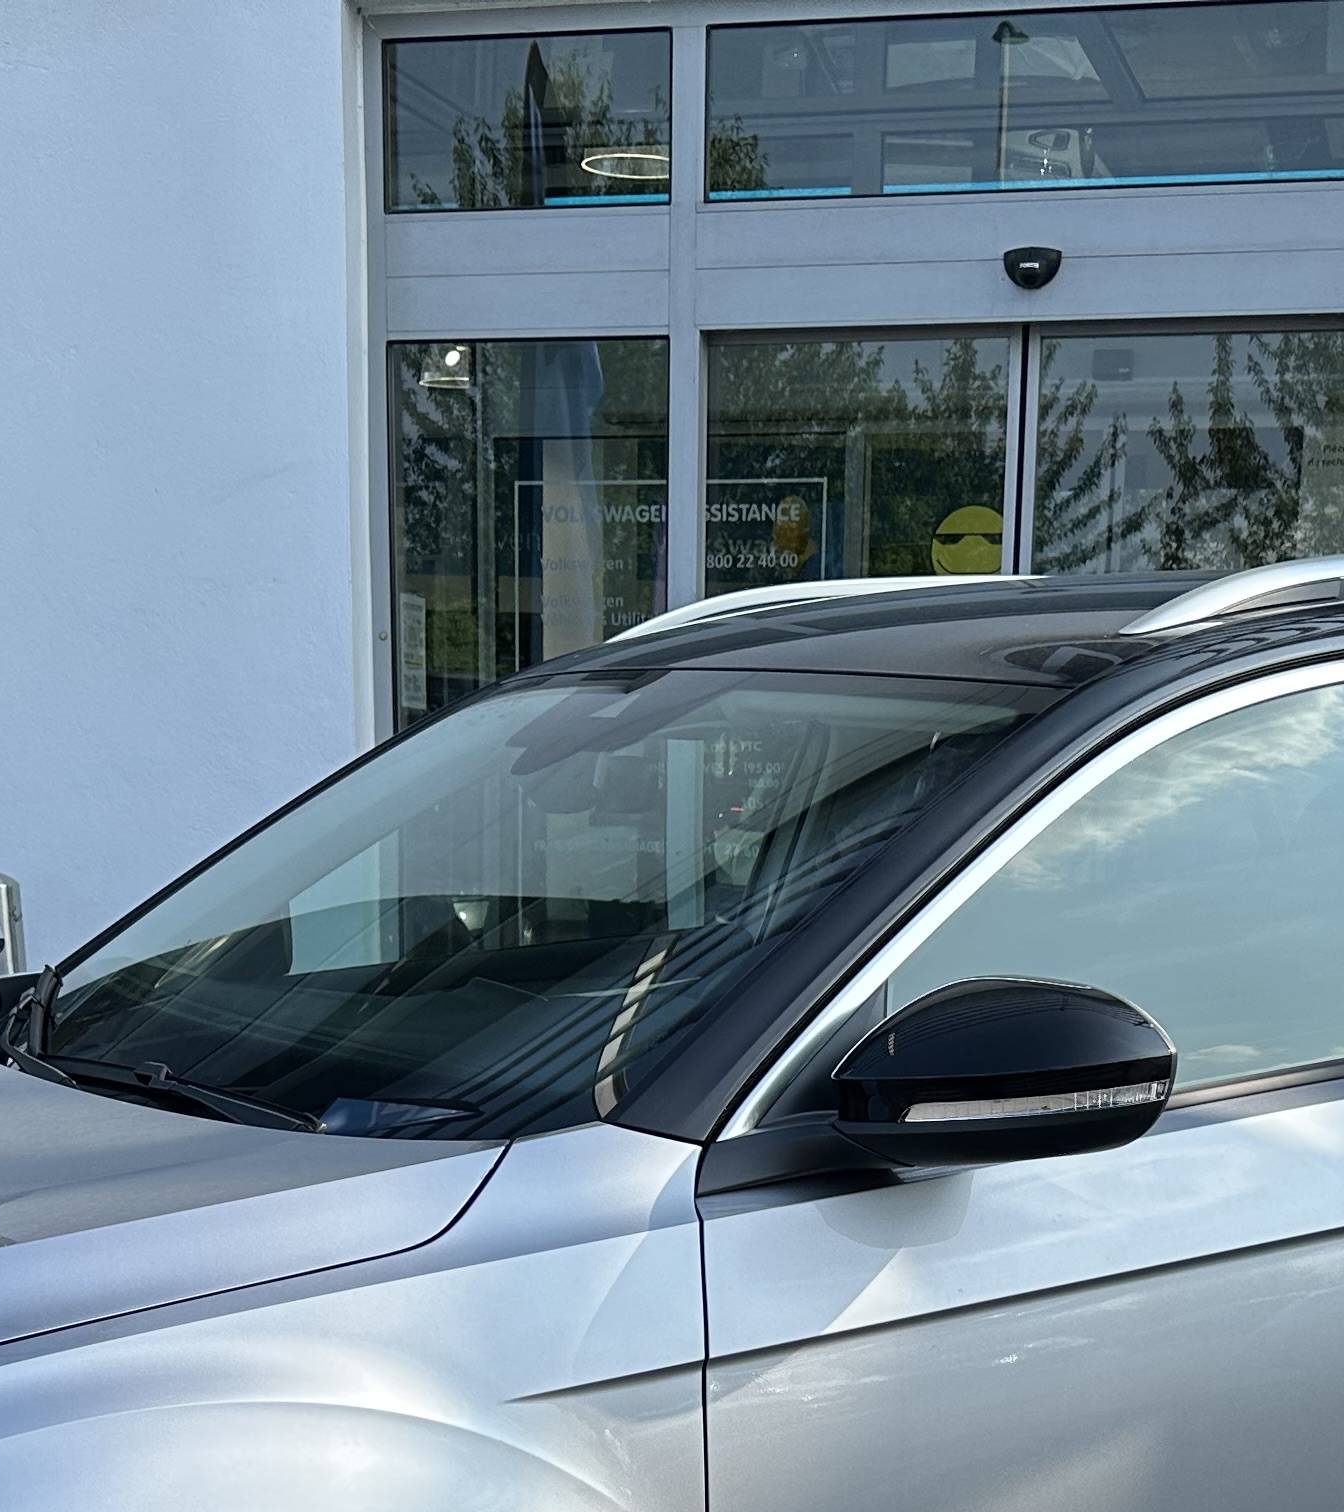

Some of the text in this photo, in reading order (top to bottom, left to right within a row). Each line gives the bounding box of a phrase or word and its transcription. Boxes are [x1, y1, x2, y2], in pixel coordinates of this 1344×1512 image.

[736, 553, 755, 568] 22
[758, 553, 776, 568] 40
[779, 552, 799, 568] 00
